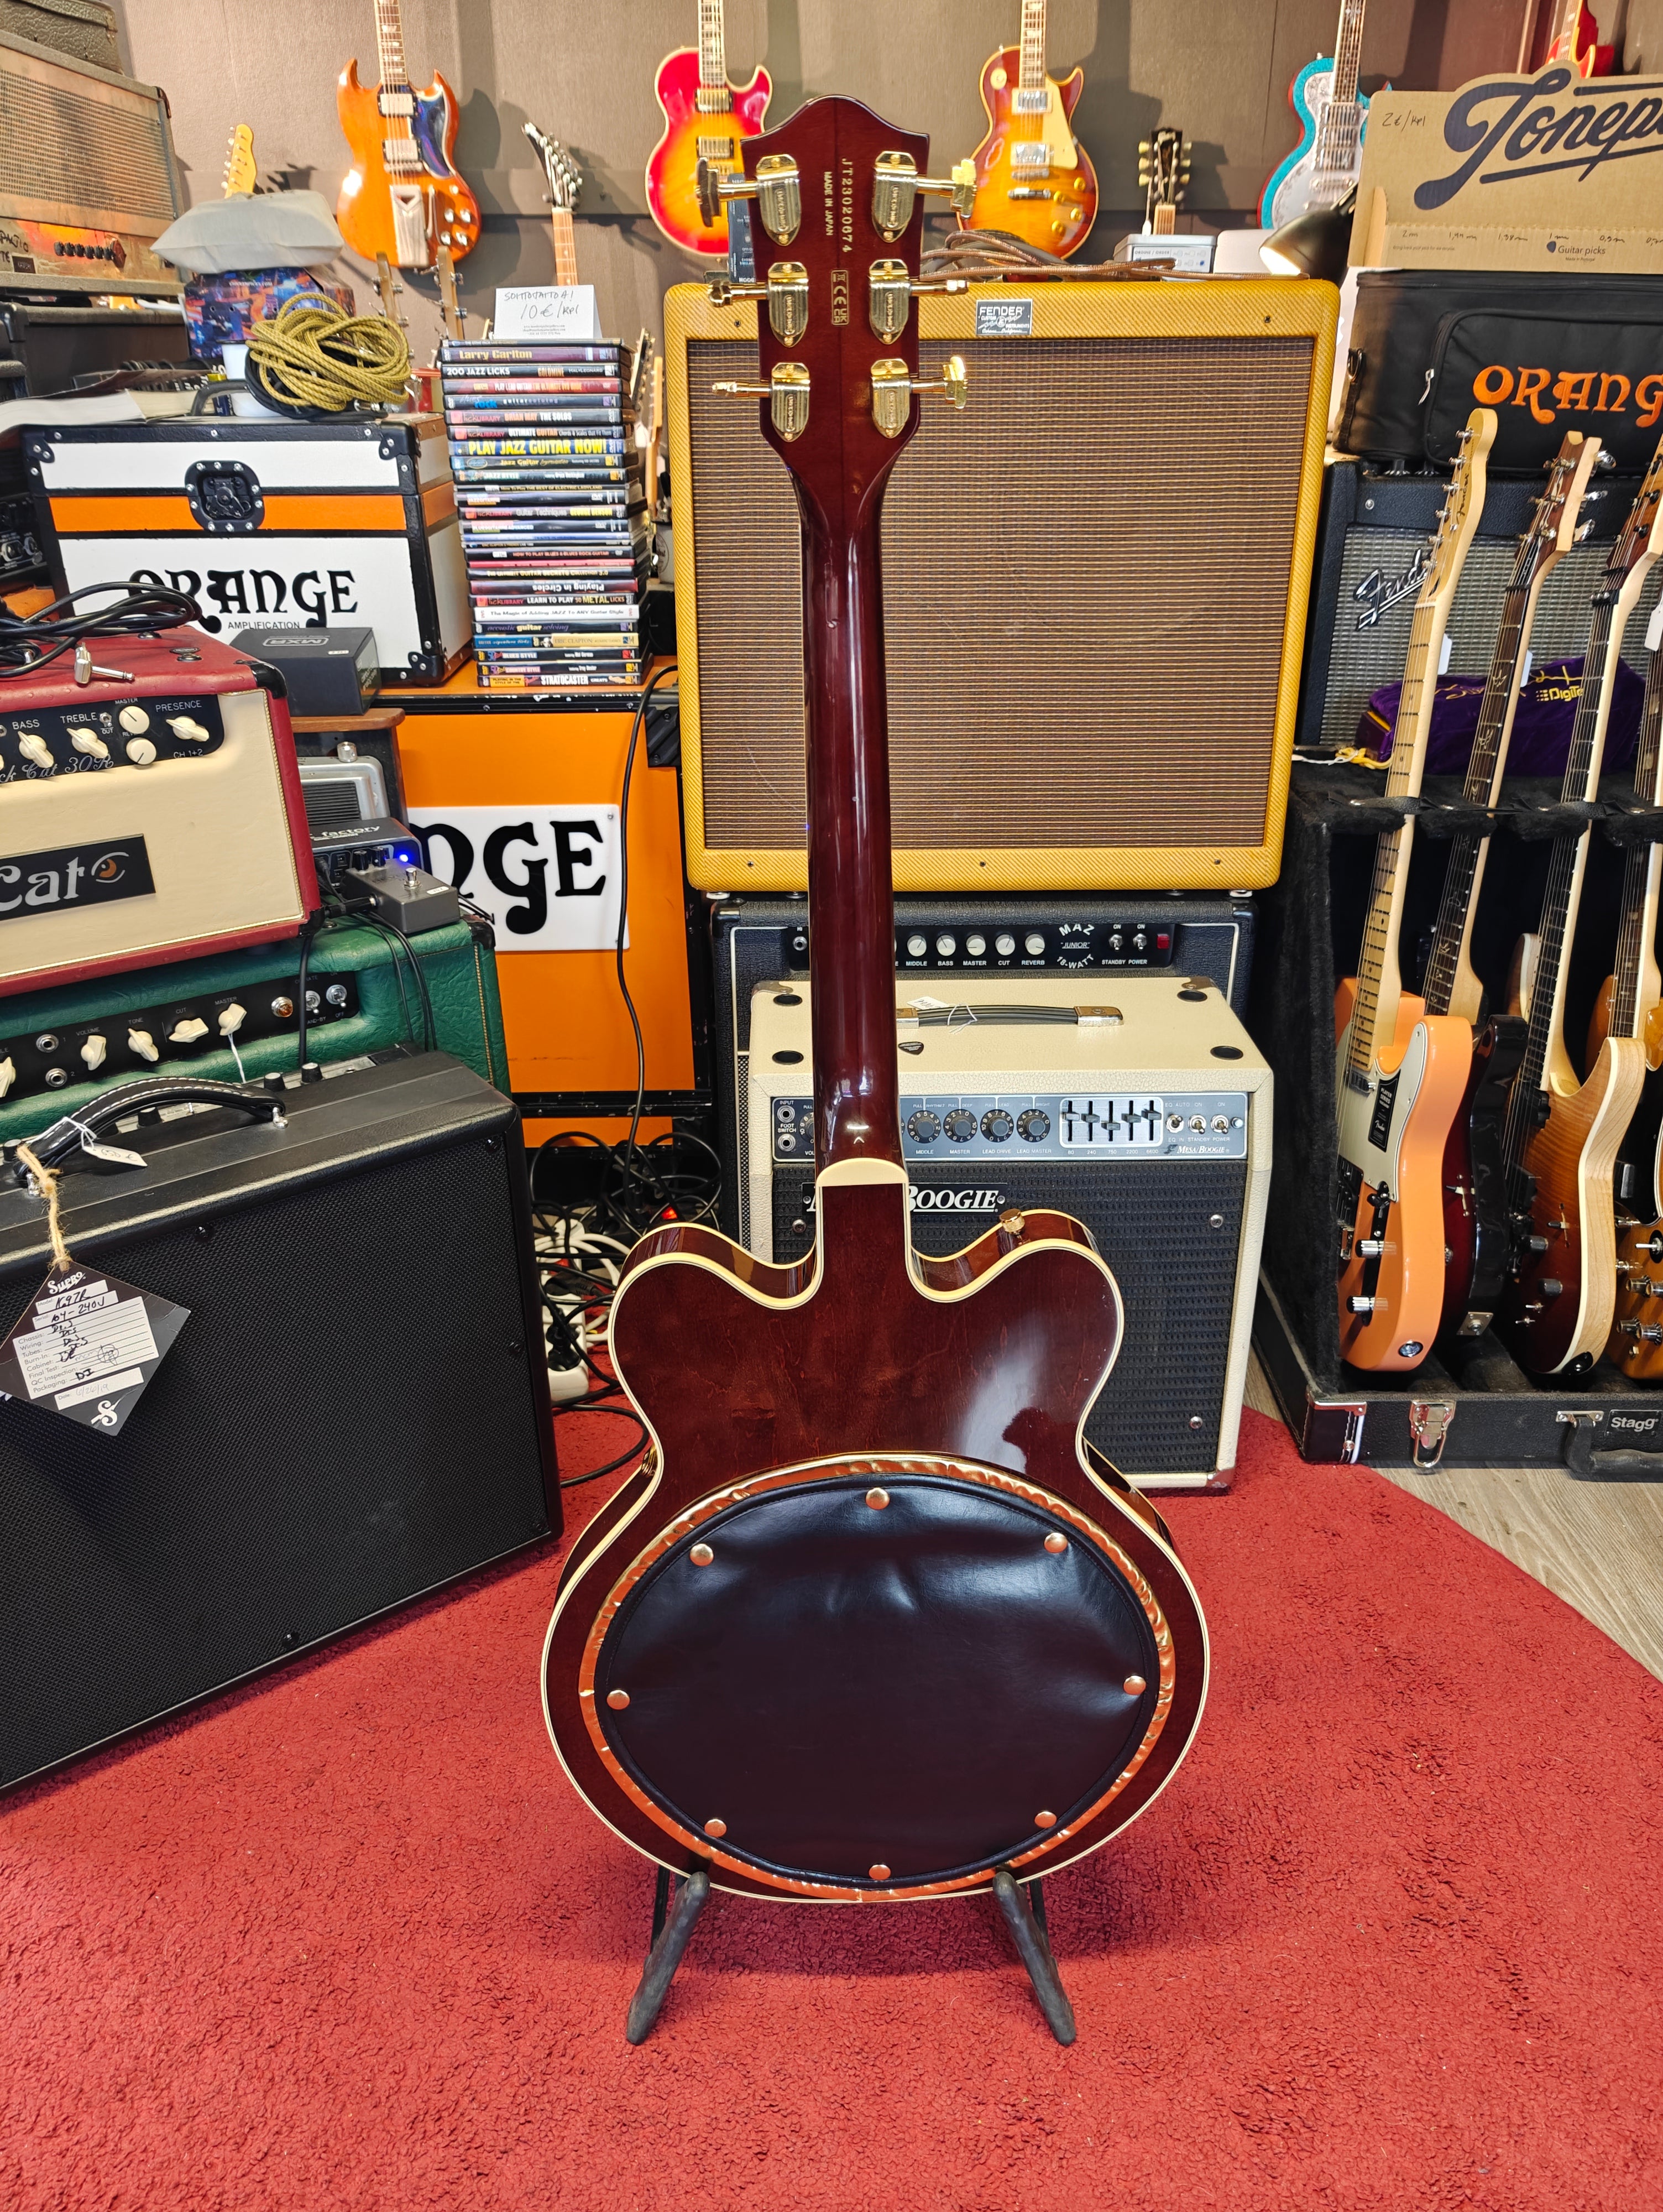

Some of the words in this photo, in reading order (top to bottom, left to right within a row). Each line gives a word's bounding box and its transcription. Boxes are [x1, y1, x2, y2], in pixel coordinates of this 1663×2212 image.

[824, 171, 833, 196] MADE
[824, 198, 833, 207] IN
[841, 158, 853, 253] JT23020674
[825, 210, 834, 236] JAPAN
[1558, 246, 1582, 254] Guitar
[1585, 246, 1606, 257] picks
[979, 306, 1023, 316] FENDER
[459, 350, 489, 360] Larry
[492, 349, 532, 360] Carlton
[447, 367, 464, 375] 200
[466, 367, 486, 375] JAZZ
[487, 367, 510, 375] LICKS
[474, 399, 497, 408] rock
[504, 413, 524, 421] BRIAN
[525, 413, 537, 421] MAY
[540, 413, 551, 421] THE
[552, 412, 572, 421] SOLOS
[508, 428, 536, 437] ULTIMATE
[536, 428, 558, 436] GUITAR
[468, 440, 496, 455] PLAY
[500, 440, 526, 455] JAZZ
[529, 439, 571, 455] GUITAR
[574, 439, 607, 454] NOW!
[532, 584, 562, 592] Circles
[564, 583, 572, 592] in
[573, 583, 604, 592] Playing
[1356, 547, 1427, 629] Fend
[582, 595, 610, 604] METAL
[227, 621, 300, 629] AMPLIFICATION
[516, 623, 542, 632] guitar
[542, 623, 569, 632] soloing
[541, 675, 589, 686] STRATOCASTER
[1549, 684, 1584, 702] DigiTe
[12, 719, 40, 730] BASS
[60, 712, 97, 724] TREBLE
[155, 700, 202, 712] PRESENCE
[189, 749, 203, 758] 1+2
[322, 826, 380, 838] factory
[1059, 923, 1095, 936] MAZ
[1057, 953, 1094, 969] 18-WATT
[215, 997, 237, 1005] MASTER
[76, 1026, 101, 1036] VOLUME
[1380, 1087, 1392, 1098] PLAYER
[1379, 1094, 1391, 1104] SERIES
[18, 1332, 45, 1344] Chassis:
[20, 1340, 44, 1351] Wiring:
[22, 1348, 43, 1358] Tubes:
[24, 1354, 50, 1365] Burn-In:
[27, 1360, 54, 1371] Cabinet:
[29, 1368, 45, 1379] Final
[46, 1365, 60, 1373] Test:
[31, 1378, 43, 1386] QC
[44, 1367, 78, 1383] Inspection:
[33, 1379, 68, 1394] Packaging:
[1610, 1417, 1655, 1432] Stagg
